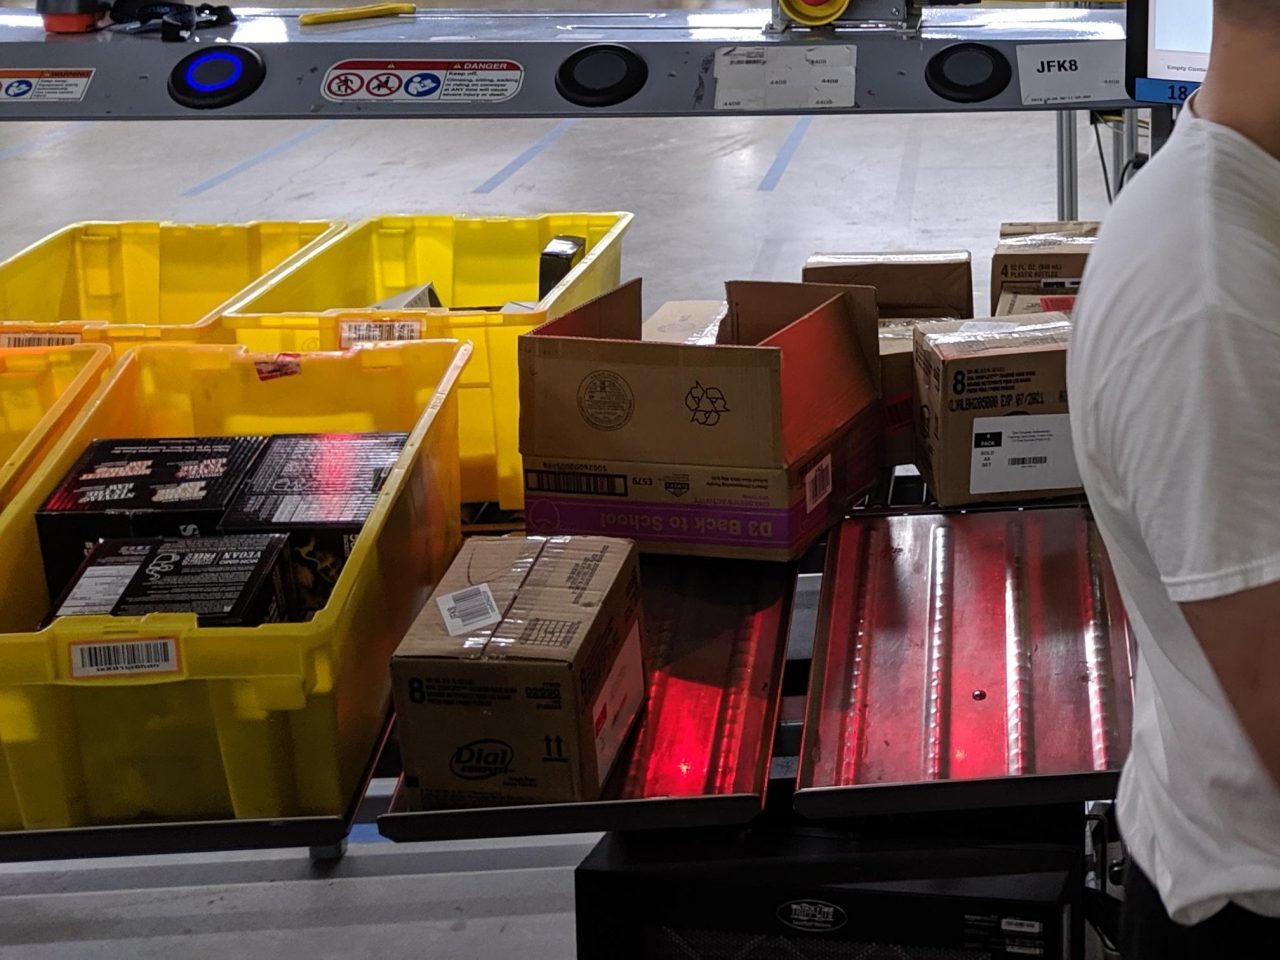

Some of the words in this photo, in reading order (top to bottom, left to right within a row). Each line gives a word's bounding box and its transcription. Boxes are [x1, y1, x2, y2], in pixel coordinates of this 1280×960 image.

[464, 62, 507, 70] DANGER
[1036, 59, 1079, 74] JFK8
[1167, 64, 1186, 72] Empty
[1001, 264, 1009, 278] 4
[953, 370, 966, 395] 8
[632, 477, 653, 486] E579
[600, 512, 663, 531] School
[669, 516, 689, 531] to
[694, 517, 741, 536] Back
[747, 520, 773, 537] D3
[222, 551, 262, 560] VEGAN
[408, 677, 426, 704] 8
[454, 745, 508, 766] Dial
